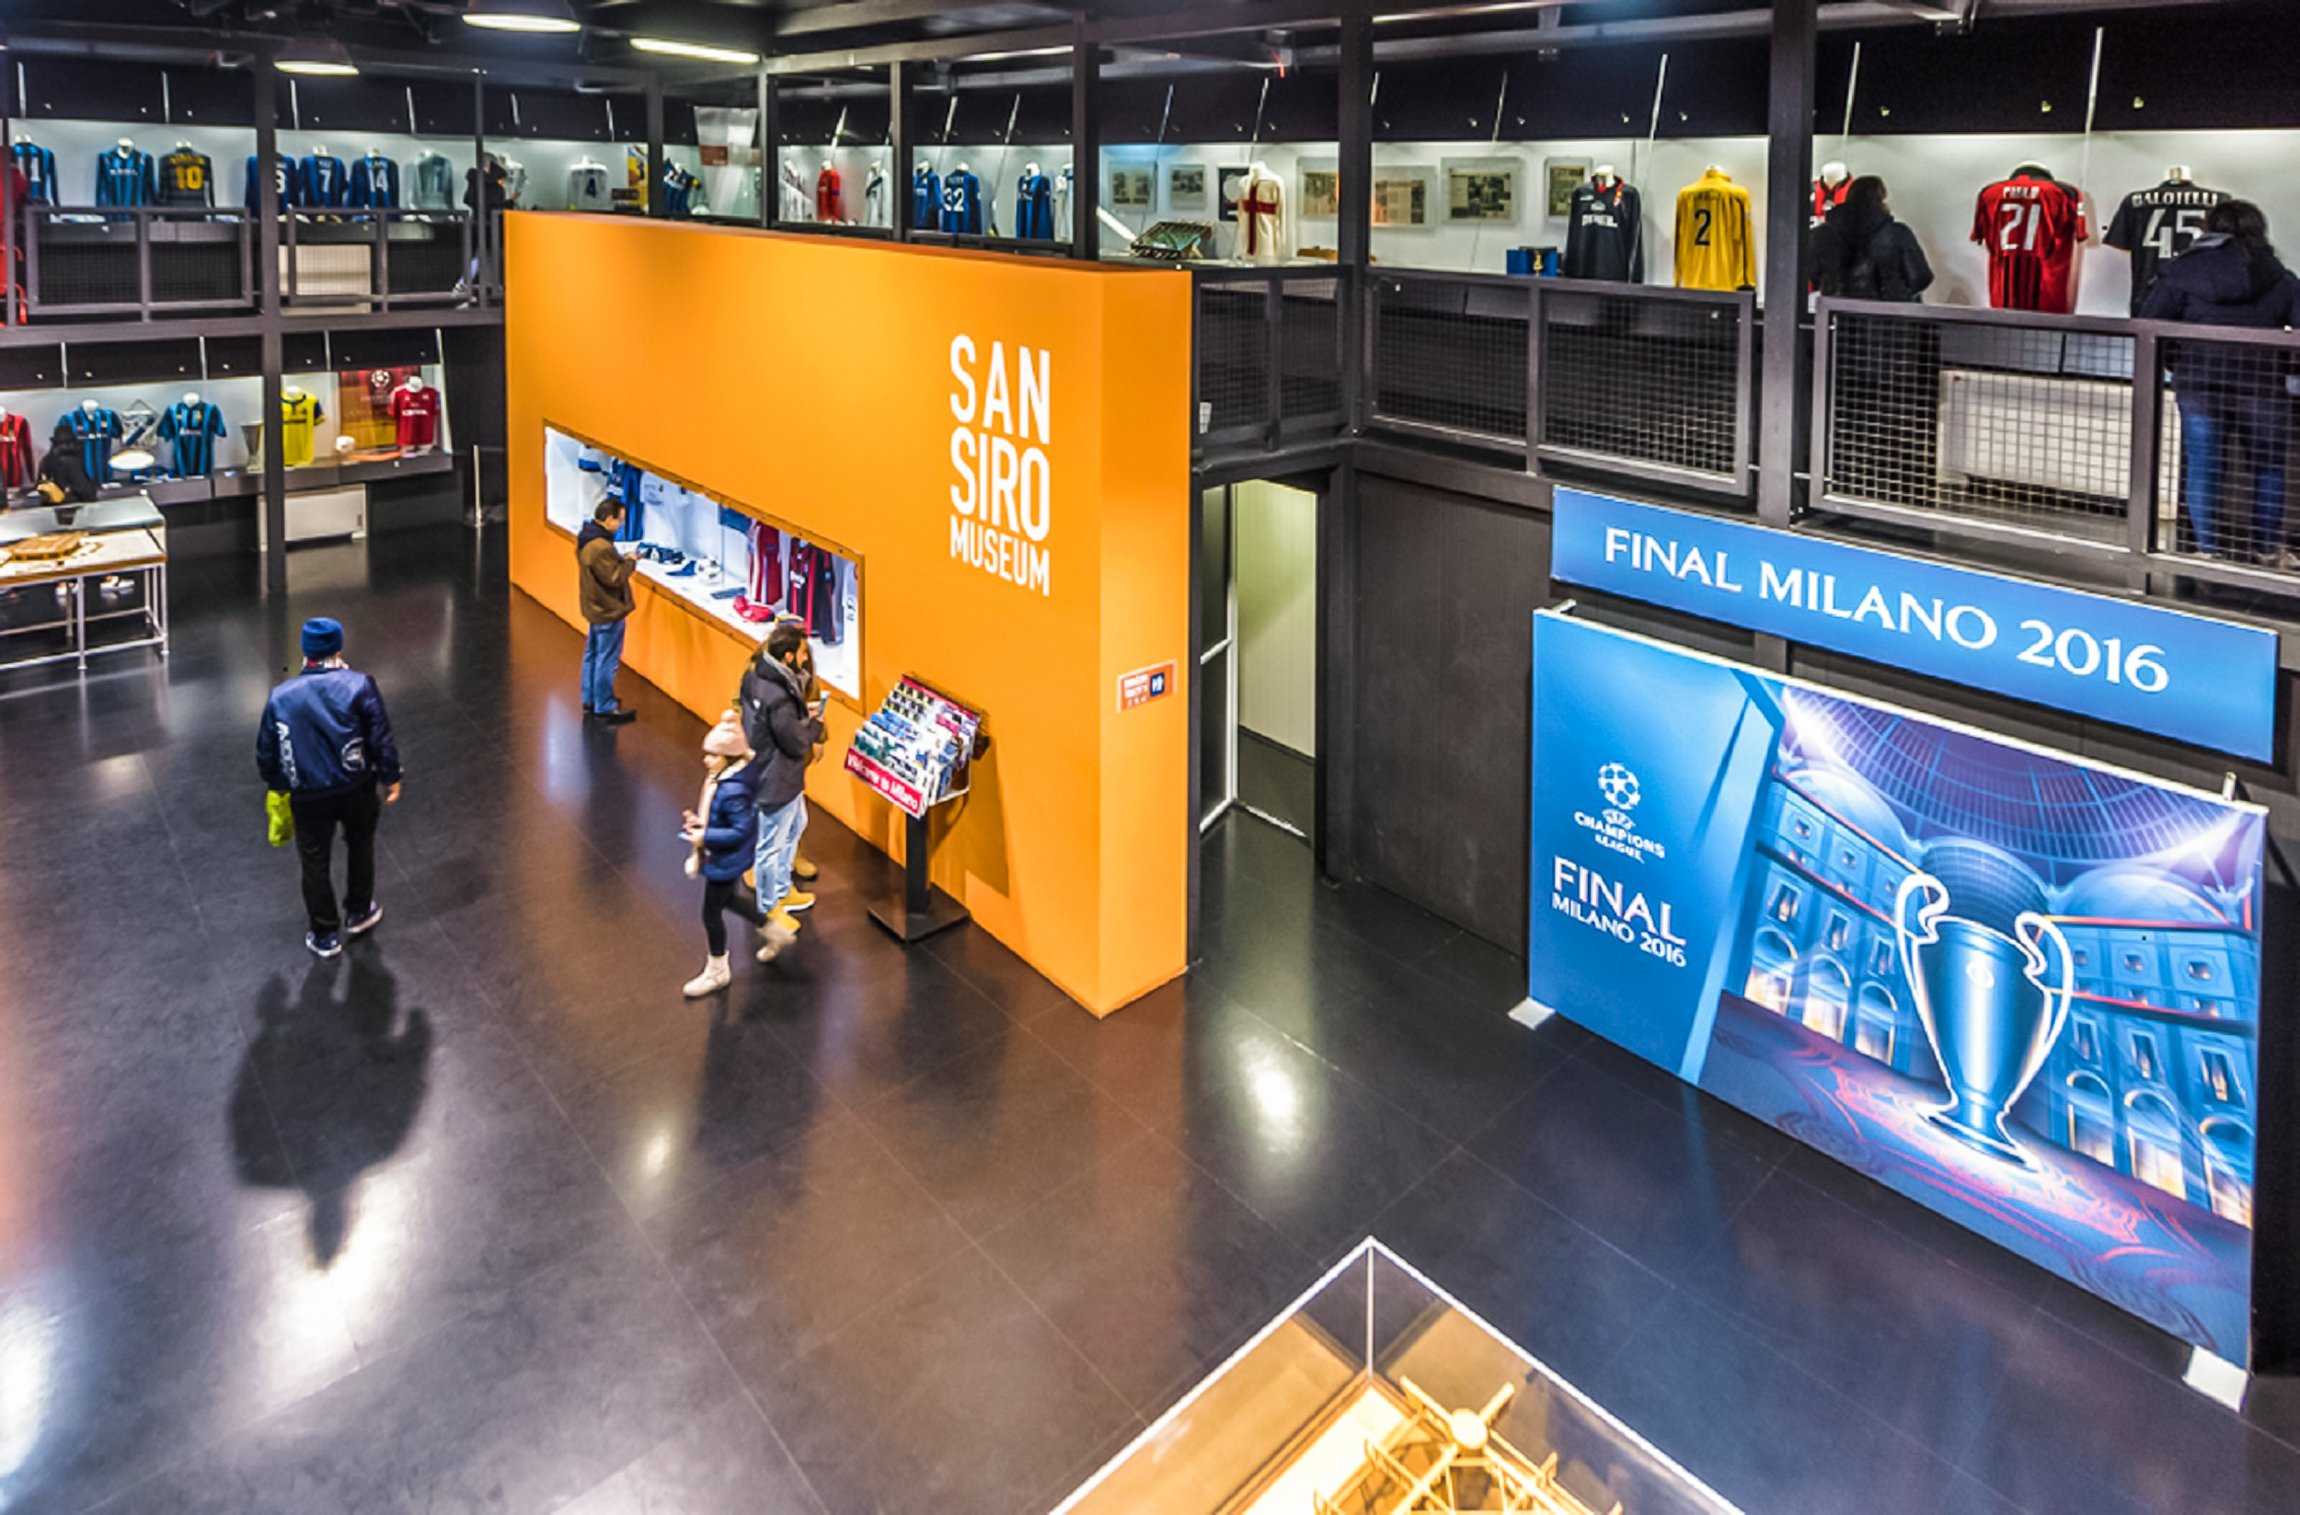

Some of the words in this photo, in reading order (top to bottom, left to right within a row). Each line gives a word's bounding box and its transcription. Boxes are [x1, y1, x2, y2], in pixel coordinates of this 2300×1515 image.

[175, 165, 204, 190] 10
[319, 169, 332, 193] 7
[368, 168, 389, 193] 14
[586, 176, 598, 198] 4
[943, 187, 965, 212] 32
[1693, 208, 1712, 247] 2
[2001, 203, 2041, 251] 21
[2141, 209, 2207, 260] 45
[950, 333, 1051, 446] SAN
[950, 425, 1051, 542] SIRO
[950, 513, 1051, 597] MUSEUM
[1604, 527, 1743, 593] FINAL
[1759, 560, 1999, 651] MILANO
[2016, 619, 2171, 693] 2016
[1573, 811, 1666, 859] CHAMPIONS
[1594, 833, 1645, 864] LEAGUE
[1554, 855, 1687, 947] FINAL
[1551, 891, 1636, 944] MILANO
[1640, 931, 1688, 968] 2016
